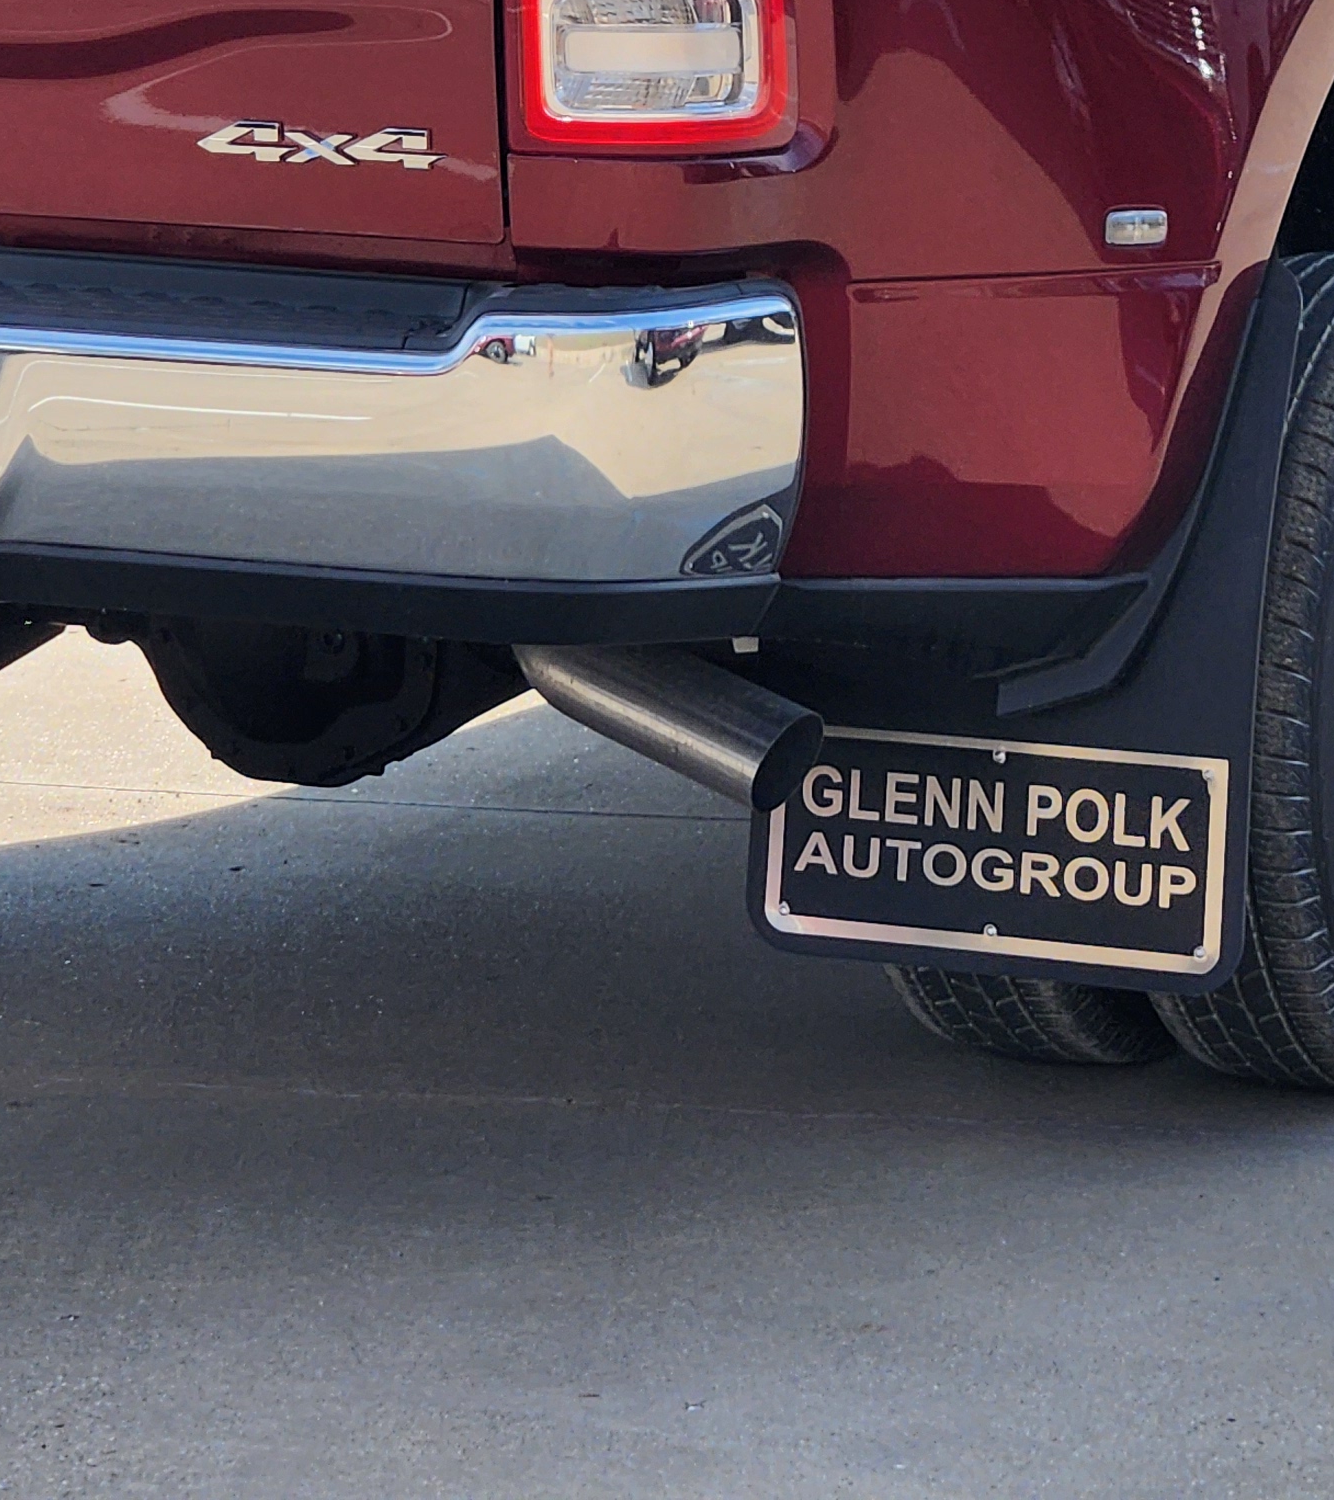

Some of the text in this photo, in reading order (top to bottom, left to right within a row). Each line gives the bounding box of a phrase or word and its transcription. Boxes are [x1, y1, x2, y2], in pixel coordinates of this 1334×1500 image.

[196, 119, 449, 171] 4x4
[802, 764, 1192, 853] GLENN POLK
[794, 831, 1197, 909] AUTOGROUP
